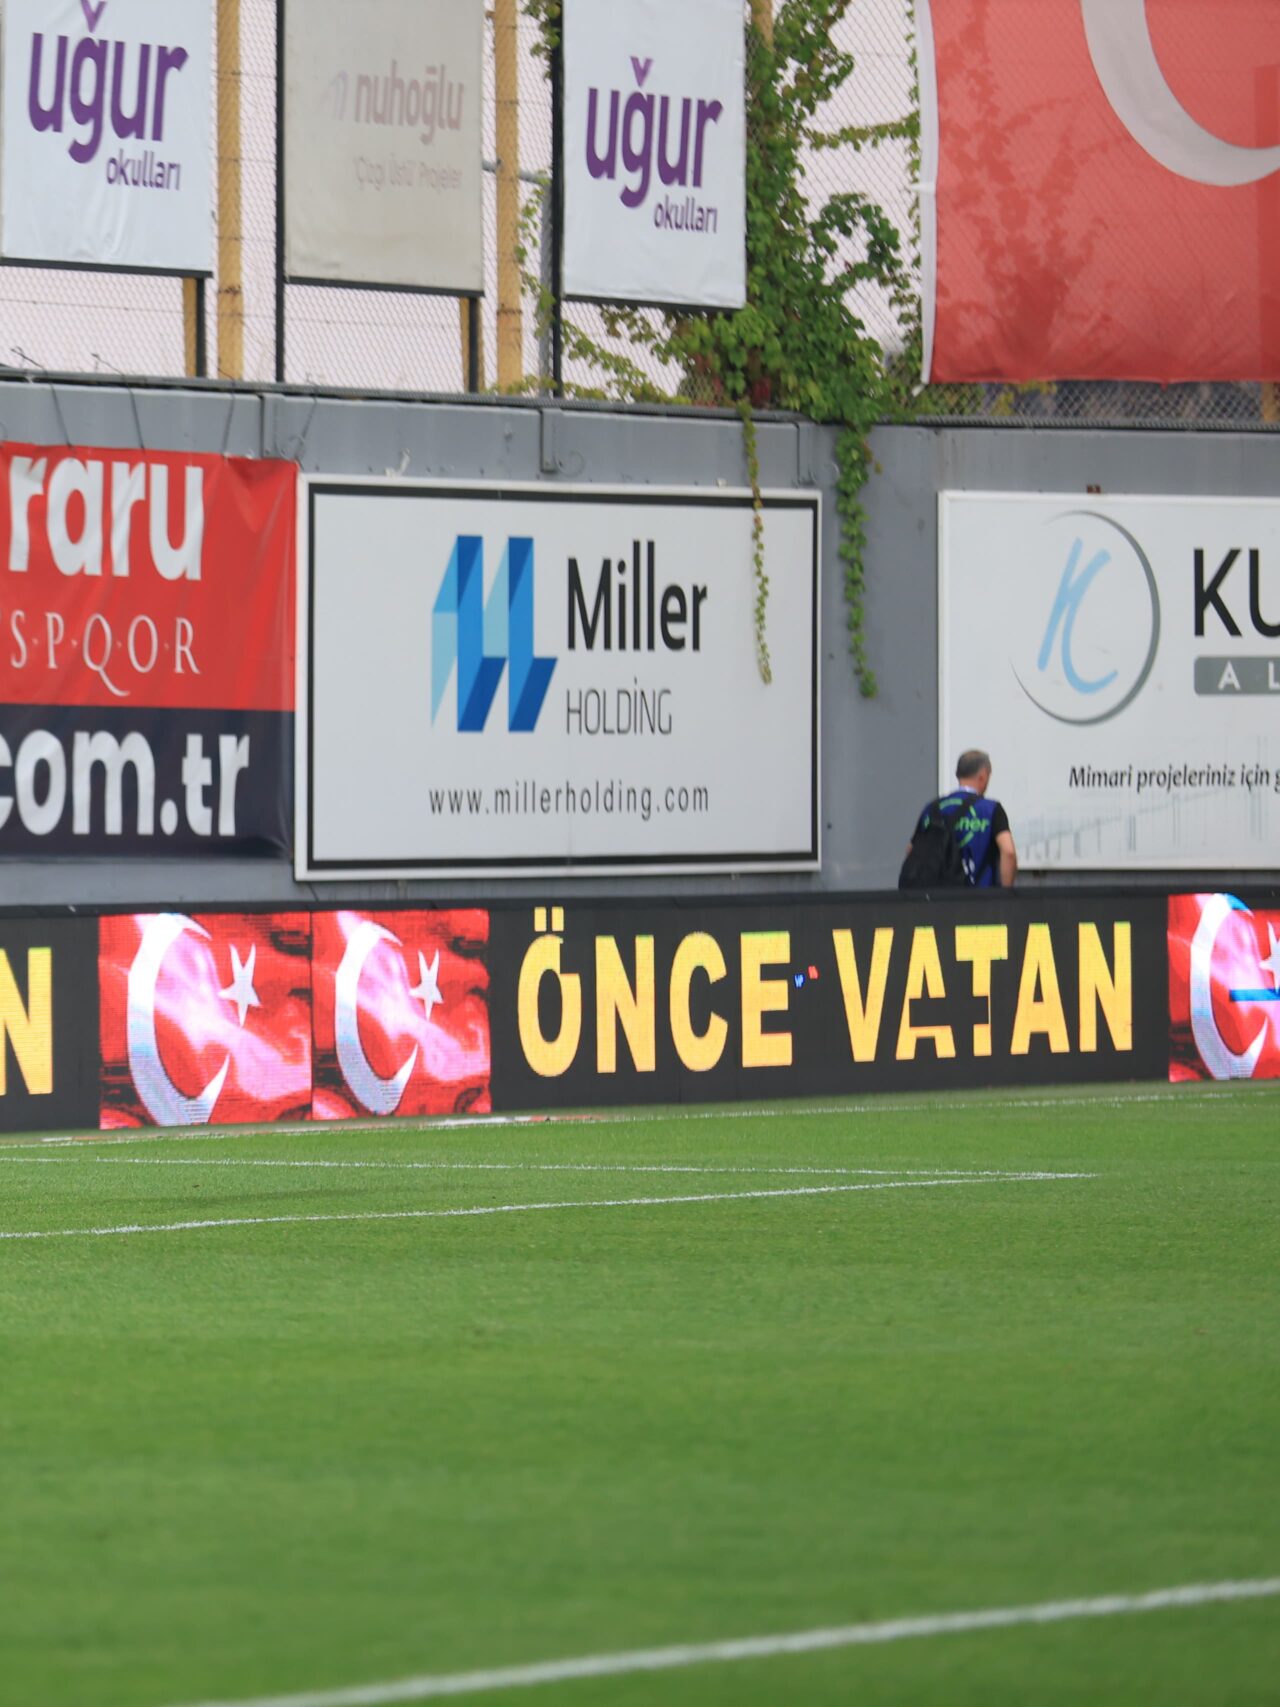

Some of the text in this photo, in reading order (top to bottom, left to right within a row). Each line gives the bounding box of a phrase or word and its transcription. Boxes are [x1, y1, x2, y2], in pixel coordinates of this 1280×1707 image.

[28, 0, 189, 164] uğur
[354, 59, 465, 146] nuhoğlu
[106, 149, 181, 190] okulları
[586, 56, 723, 208] uğur
[653, 195, 718, 233] okulları
[9, 455, 203, 581] raru
[567, 540, 709, 652] Miller
[566, 676, 673, 736] HOLDİNG
[429, 780, 710, 822] www.millerholding.com
[1069, 763, 1133, 789] Mimari
[1137, 763, 1236, 795] projeleriniz
[1240, 762, 1270, 794] için
[517, 907, 1133, 1077] ÖNCE VATAN
